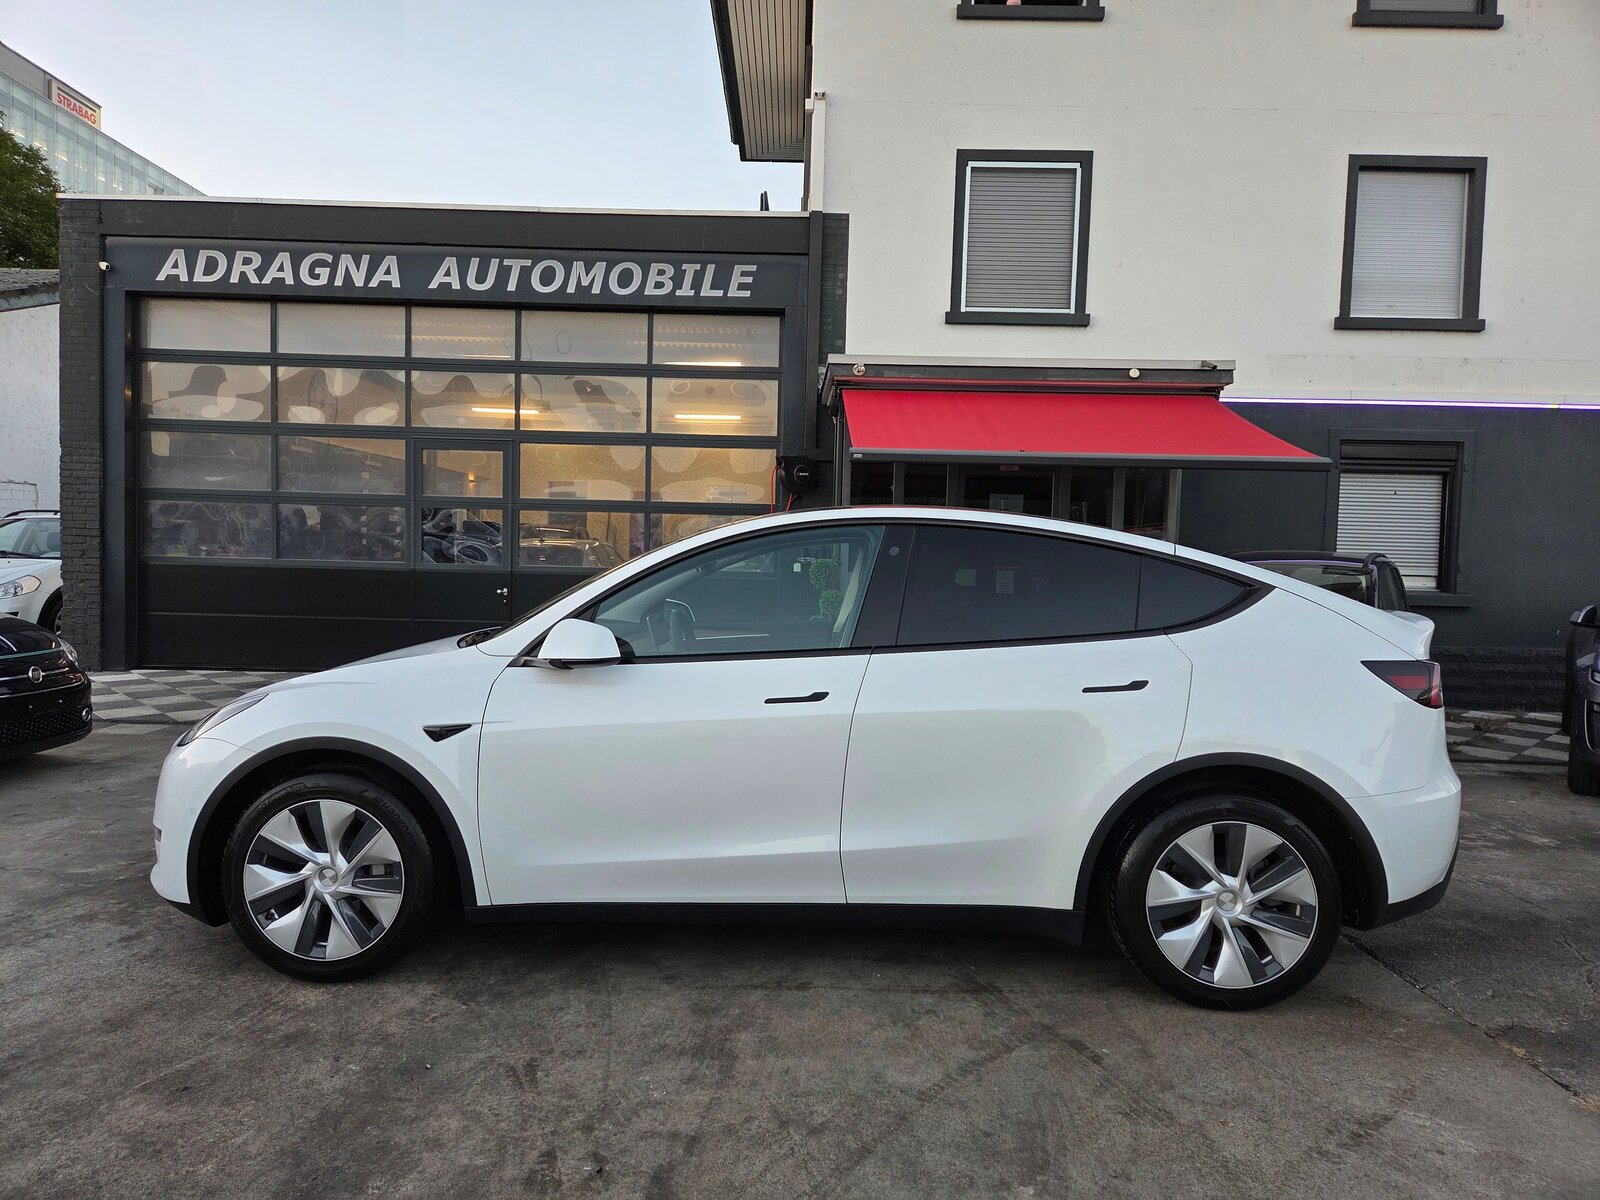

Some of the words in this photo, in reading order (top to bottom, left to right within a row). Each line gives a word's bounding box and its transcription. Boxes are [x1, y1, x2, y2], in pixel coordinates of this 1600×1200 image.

[56, 92, 97, 125] STRABAG
[155, 248, 401, 289] ADRAGNA
[427, 256, 758, 298] AUTOMOBILE
